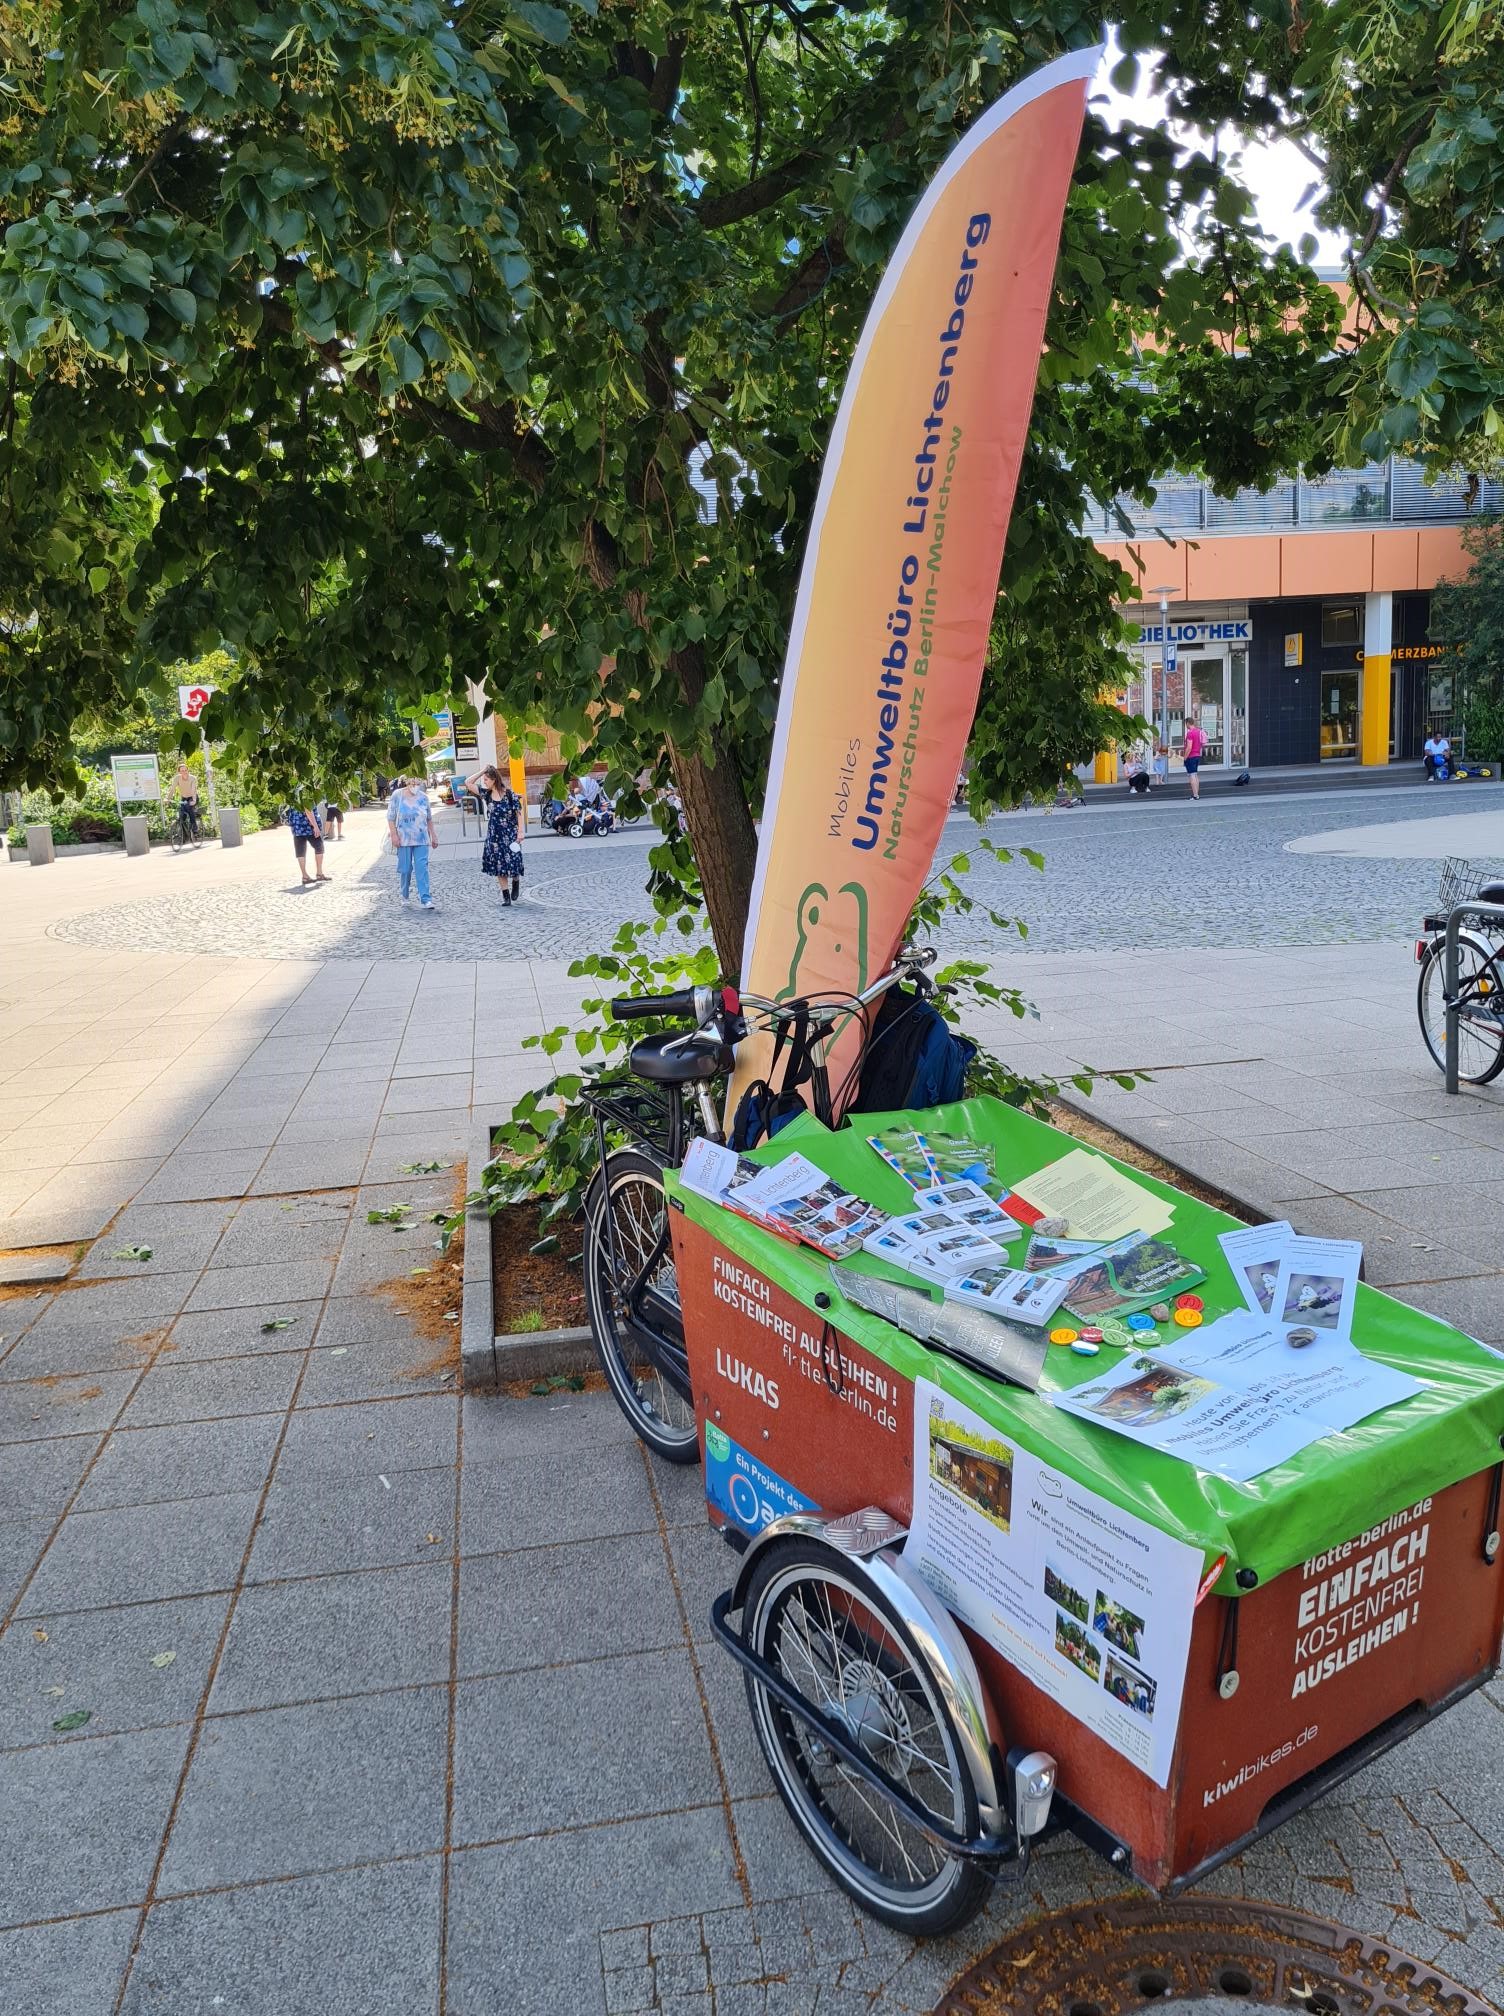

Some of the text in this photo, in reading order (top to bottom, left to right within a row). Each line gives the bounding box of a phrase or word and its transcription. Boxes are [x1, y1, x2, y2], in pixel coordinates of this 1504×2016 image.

[852, 212, 992, 850] Umweltbüro Lichtenberg
[882, 425, 963, 860] Naturschutz Berlin-Malchow
[828, 738, 861, 838] Mobiles
[713, 1278, 796, 1343] KOSTENFREI
[716, 1347, 780, 1410] LUKAS
[1182, 1408, 1217, 1428] Heute
[1216, 1394, 1237, 1407] von
[1228, 1419, 1250, 1432] Sie
[735, 1452, 804, 1511] Ein Projekt des
[928, 1482, 968, 1516] Angebote
[1031, 1498, 1049, 1517] Wir
[1051, 1516, 1064, 1528] sind
[1065, 1526, 1075, 1536] ein
[1075, 1532, 1115, 1561] Anlaufpunkt
[1115, 1558, 1124, 1567] zu
[1124, 1562, 1149, 1583] Fragen
[1066, 1496, 1108, 1526] Umweltbüro
[1109, 1521, 1150, 1553] Lichtenberg
[1302, 1496, 1433, 1580] flotte-berlin.de
[1056, 1539, 1117, 1585] Berlin-Lichtenberg.
[1091, 1552, 1104, 1565] und
[1104, 1561, 1145, 1593] Naturschutz
[1145, 1587, 1153, 1597] in
[1297, 1523, 1430, 1629] EINFACH
[1295, 1565, 1424, 1664] KOSTENFREI
[1291, 1608, 1408, 1700] AUSLEIHEN
[1203, 1724, 1319, 1808] kiwibikes.de
